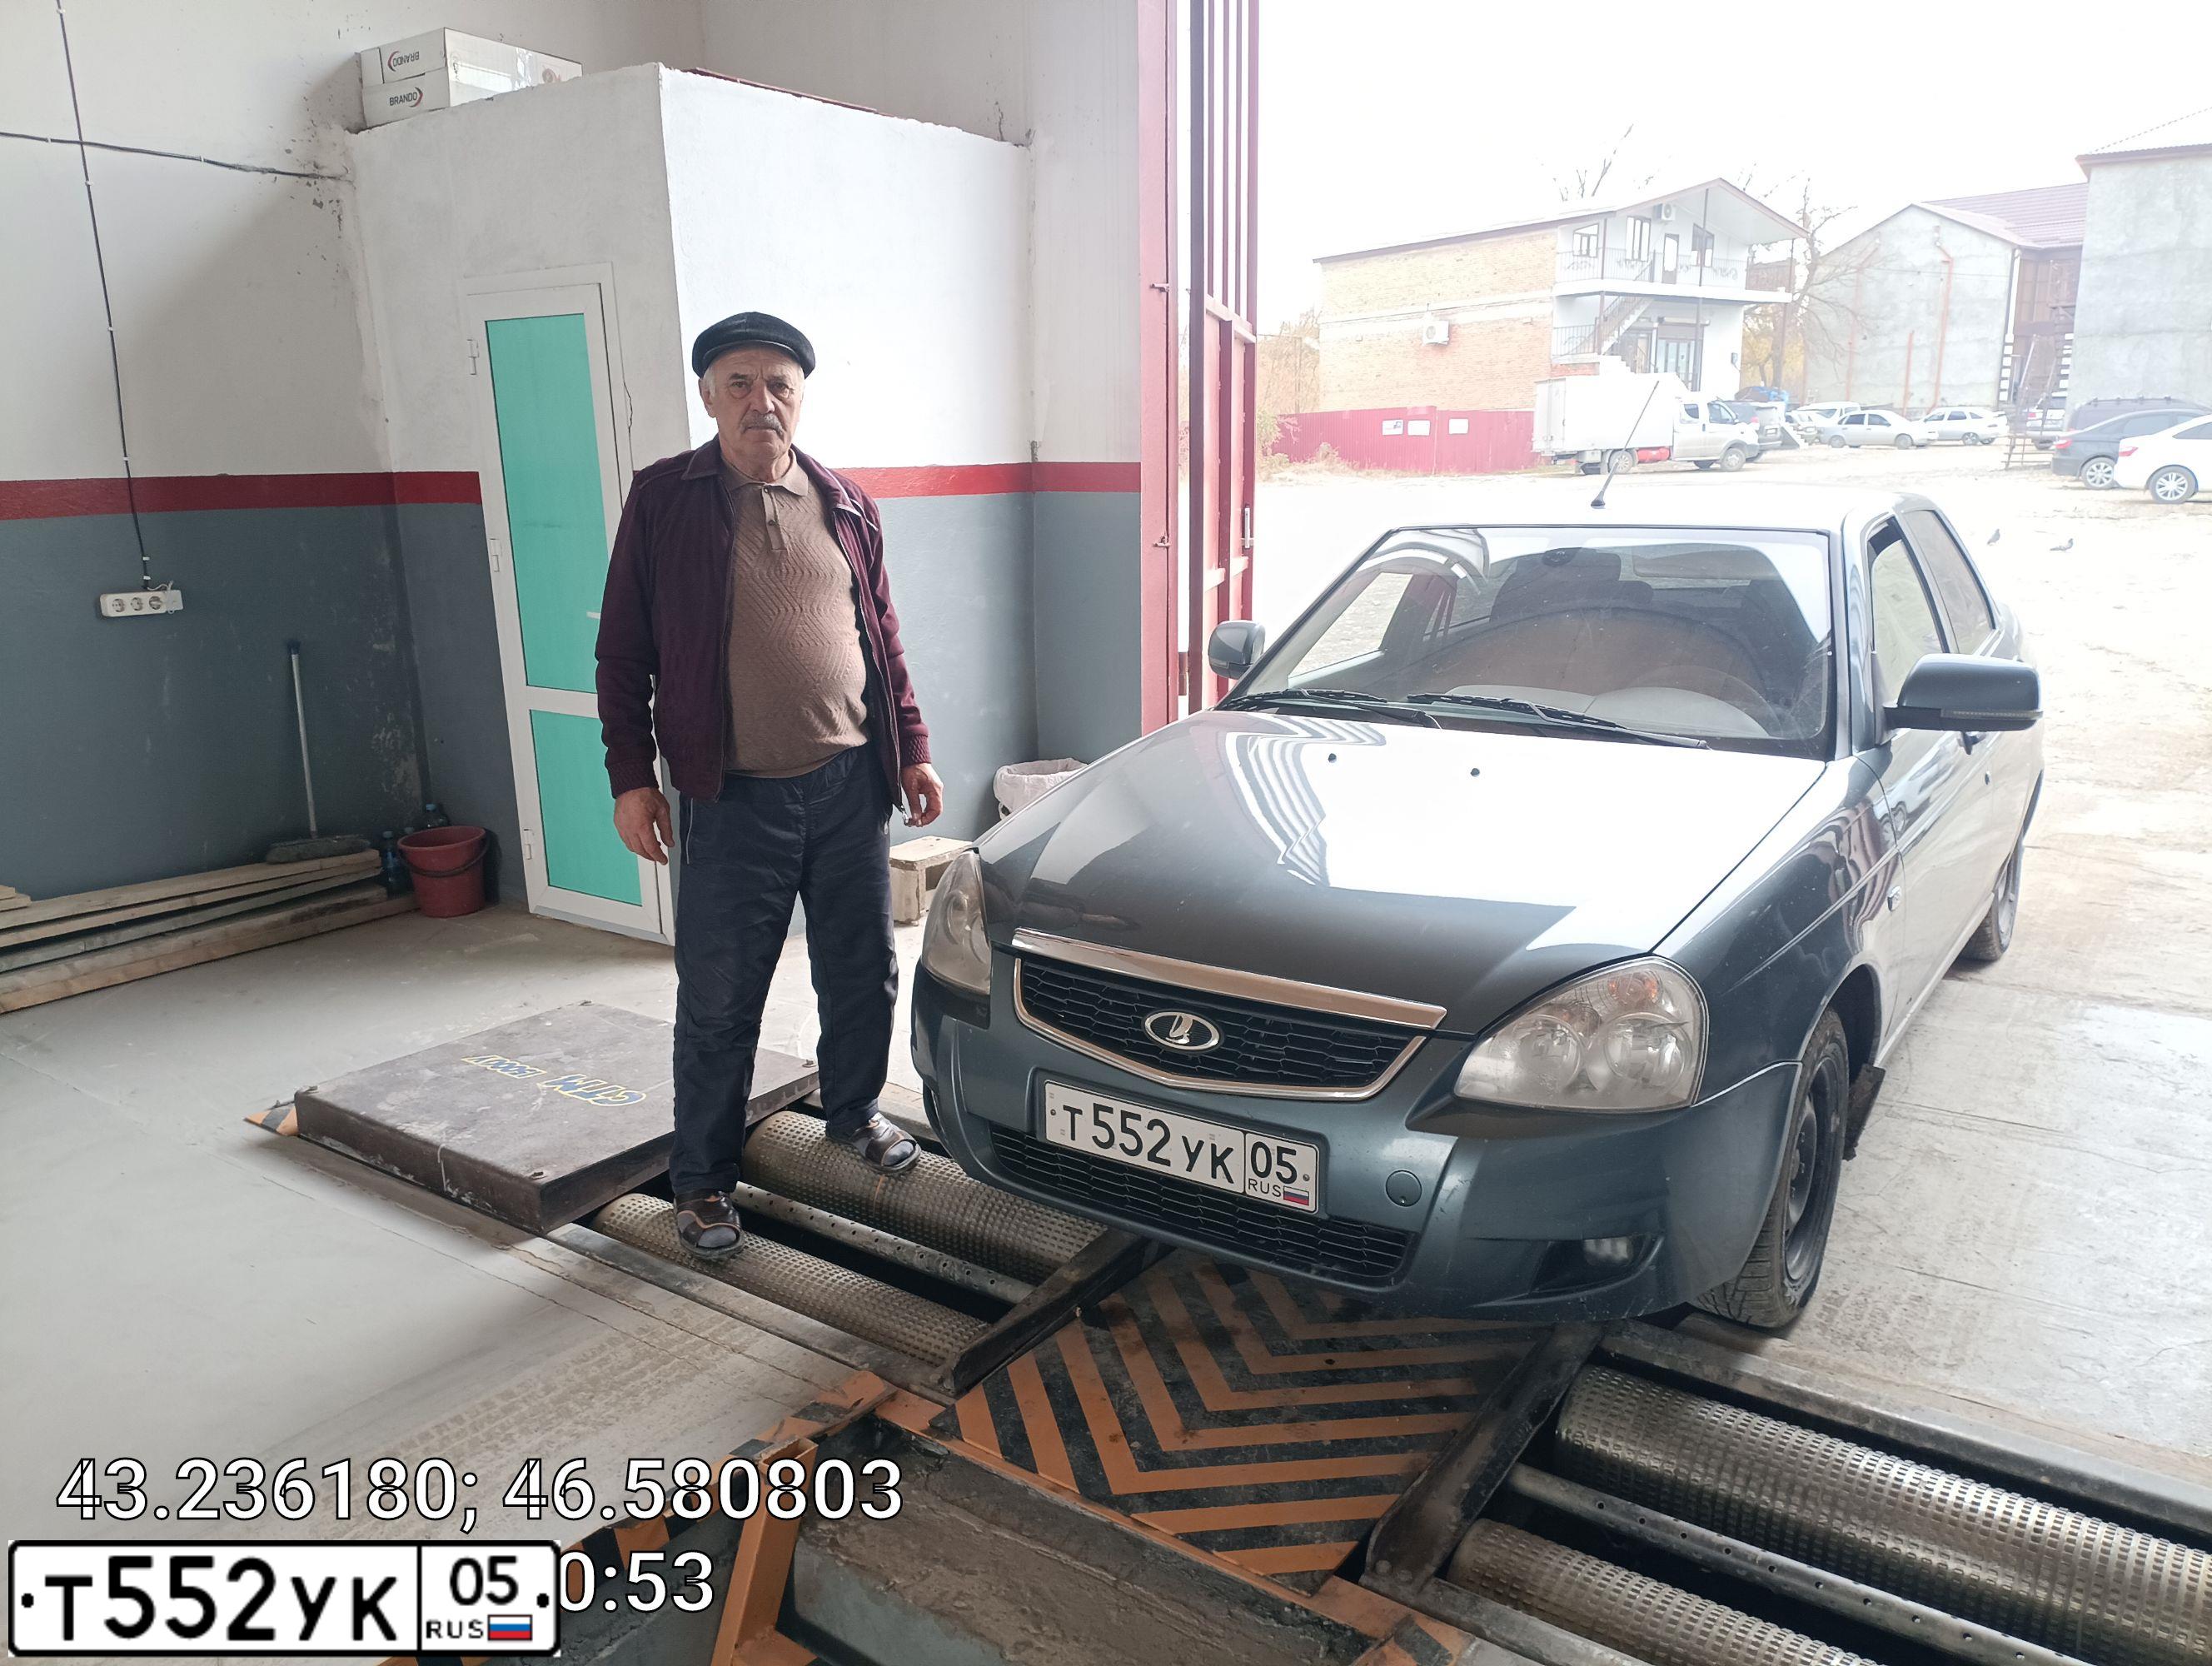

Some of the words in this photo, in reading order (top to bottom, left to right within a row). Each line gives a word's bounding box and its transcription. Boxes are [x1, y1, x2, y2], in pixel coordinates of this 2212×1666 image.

[391, 50, 420, 67] BRANDO
[389, 91, 418, 107] BRANDO
[1062, 1102, 1234, 1185] Т552УК
[1250, 1141, 1298, 1185] 05
[1248, 1177, 1283, 1198] RUS
